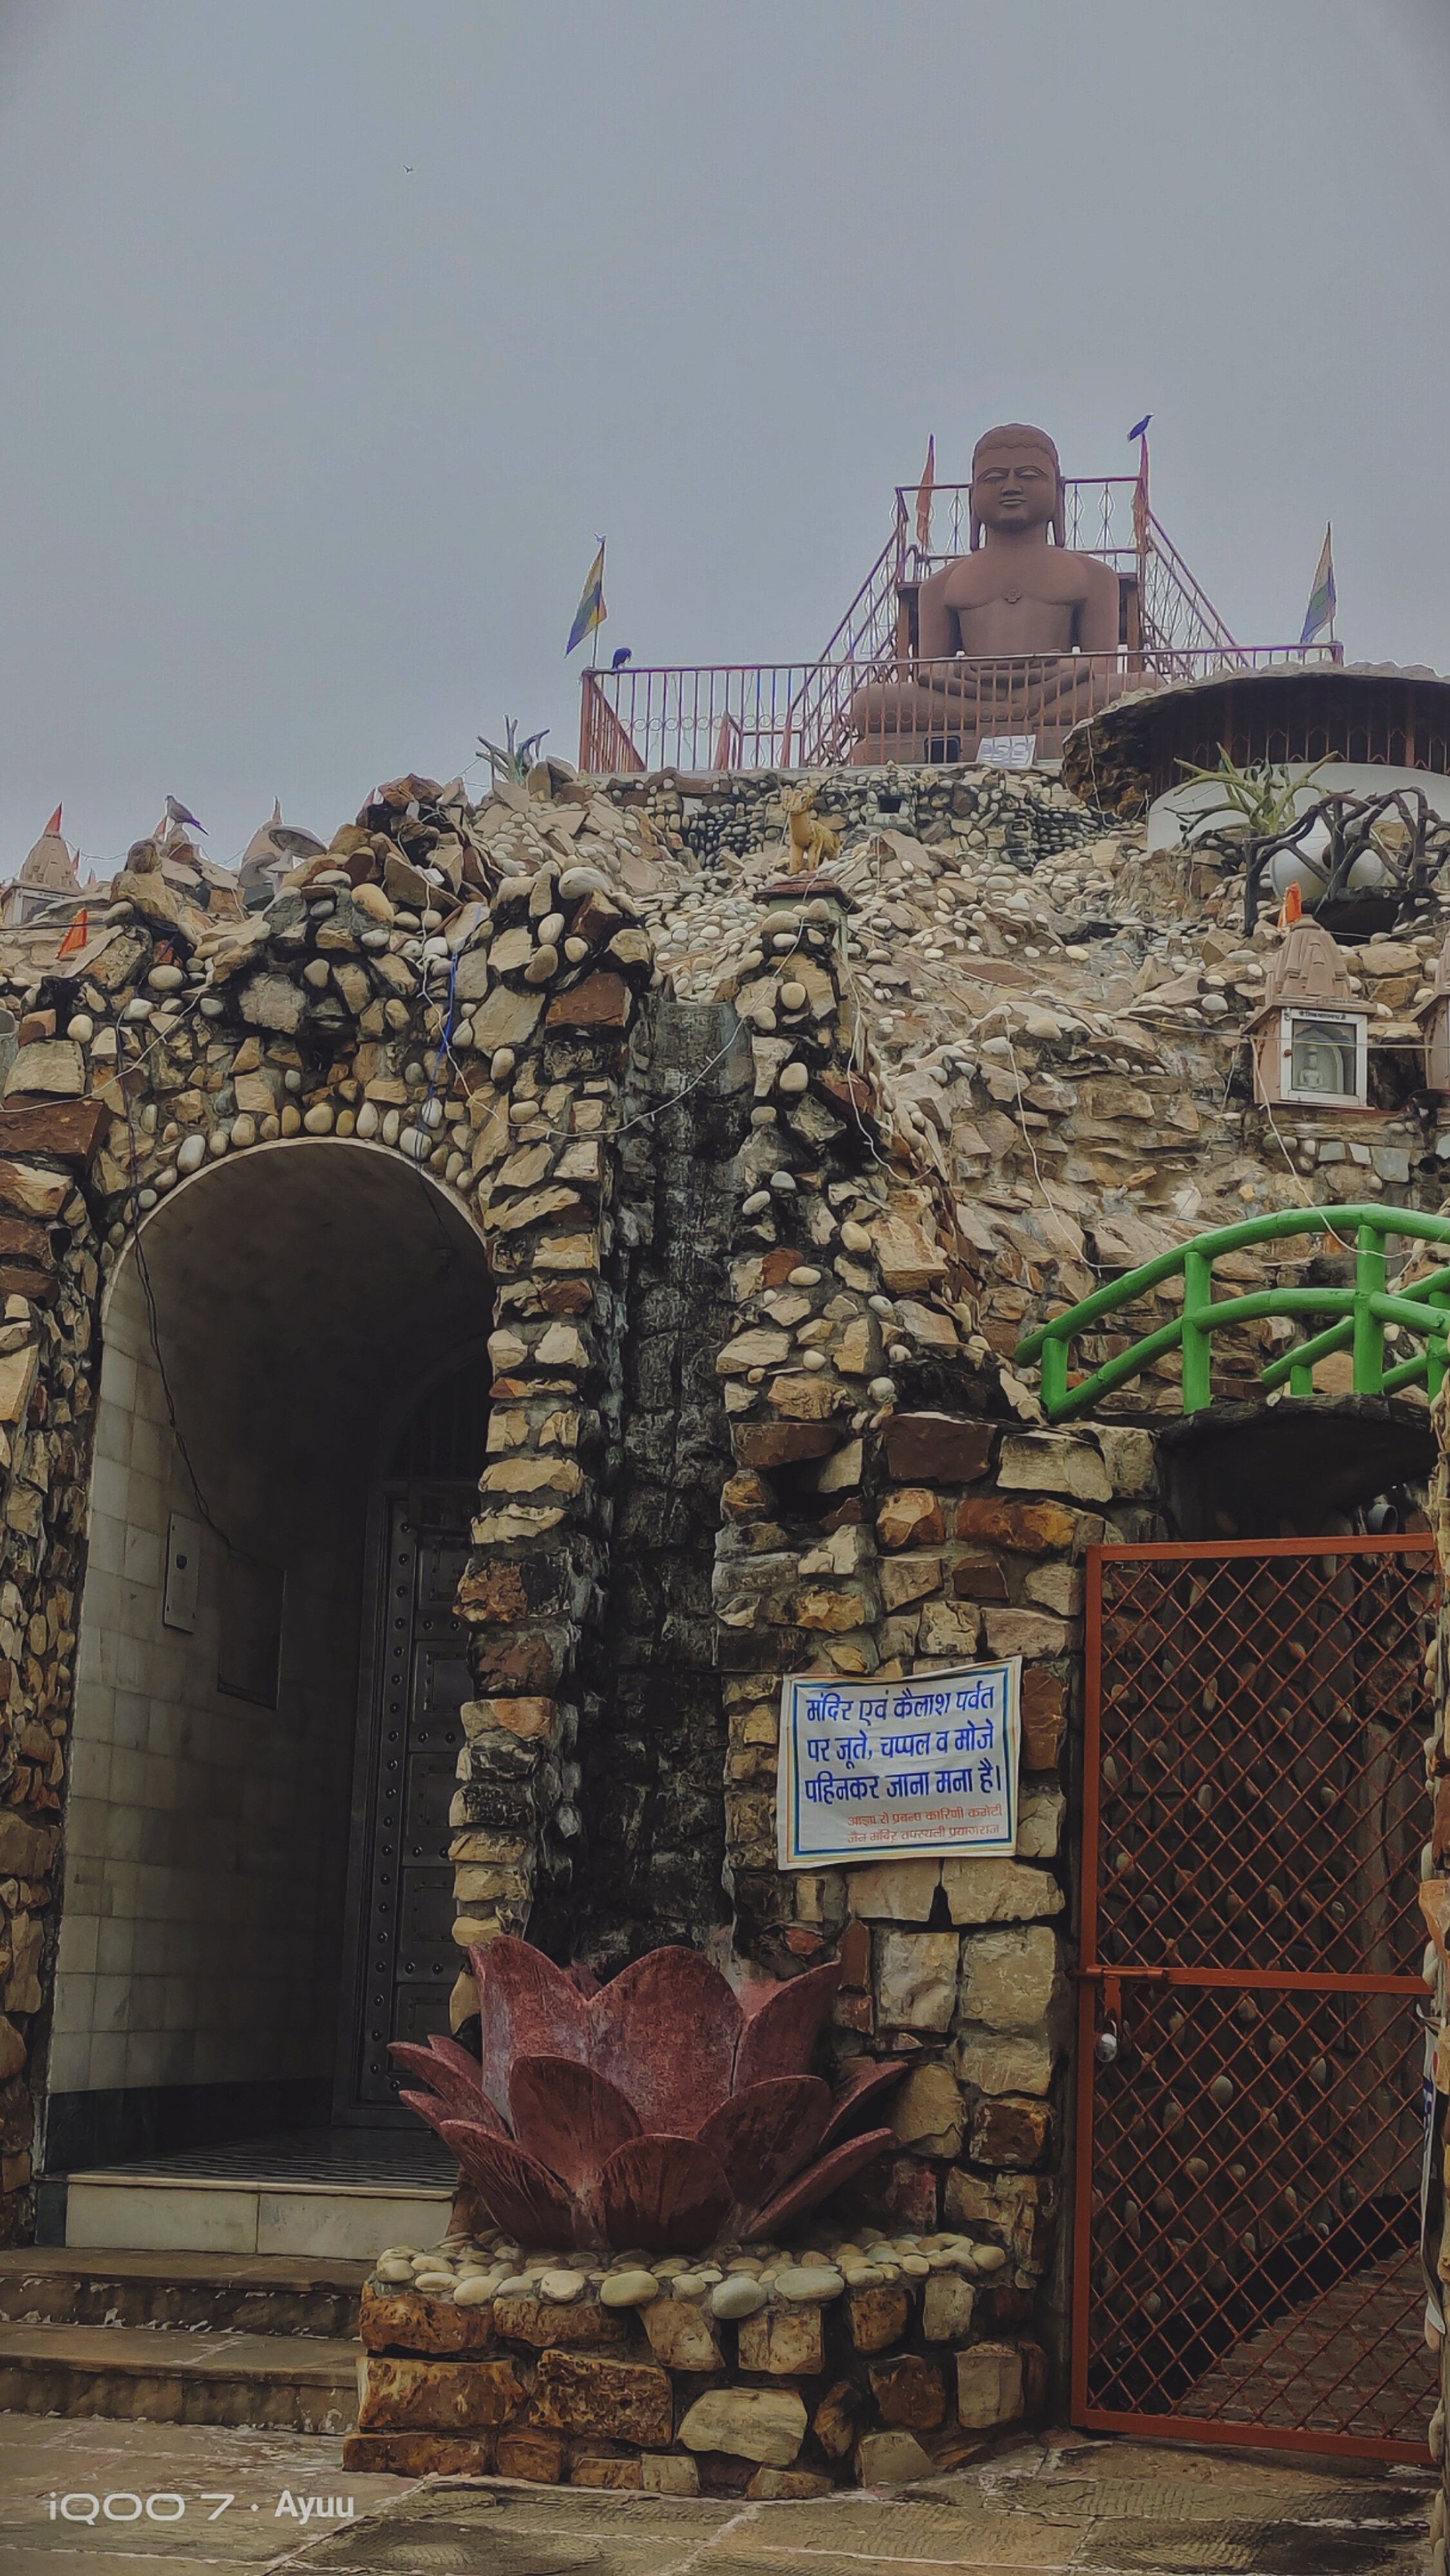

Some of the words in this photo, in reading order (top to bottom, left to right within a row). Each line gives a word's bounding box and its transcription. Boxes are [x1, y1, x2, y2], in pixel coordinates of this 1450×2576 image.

[805, 1692, 854, 1721] मंदिर
[859, 1689, 888, 1726] एवं
[893, 1687, 951, 1718] कैलाश
[956, 1680, 994, 1710] पर्वत
[807, 1738, 830, 1762] पर
[834, 1728, 872, 1769] जूते,
[880, 1732, 931, 1758] चप्पल
[936, 1730, 949, 1753] व
[954, 1718, 993, 1752] मोजे
[805, 1770, 880, 1804] पहिनकर
[885, 1772, 930, 1798] जाना
[934, 1768, 973, 1794] मना
[977, 1757, 1001, 1793] है।
[967, 1803, 1002, 1819] कमेटी
[847, 1830, 866, 1843] जैन
